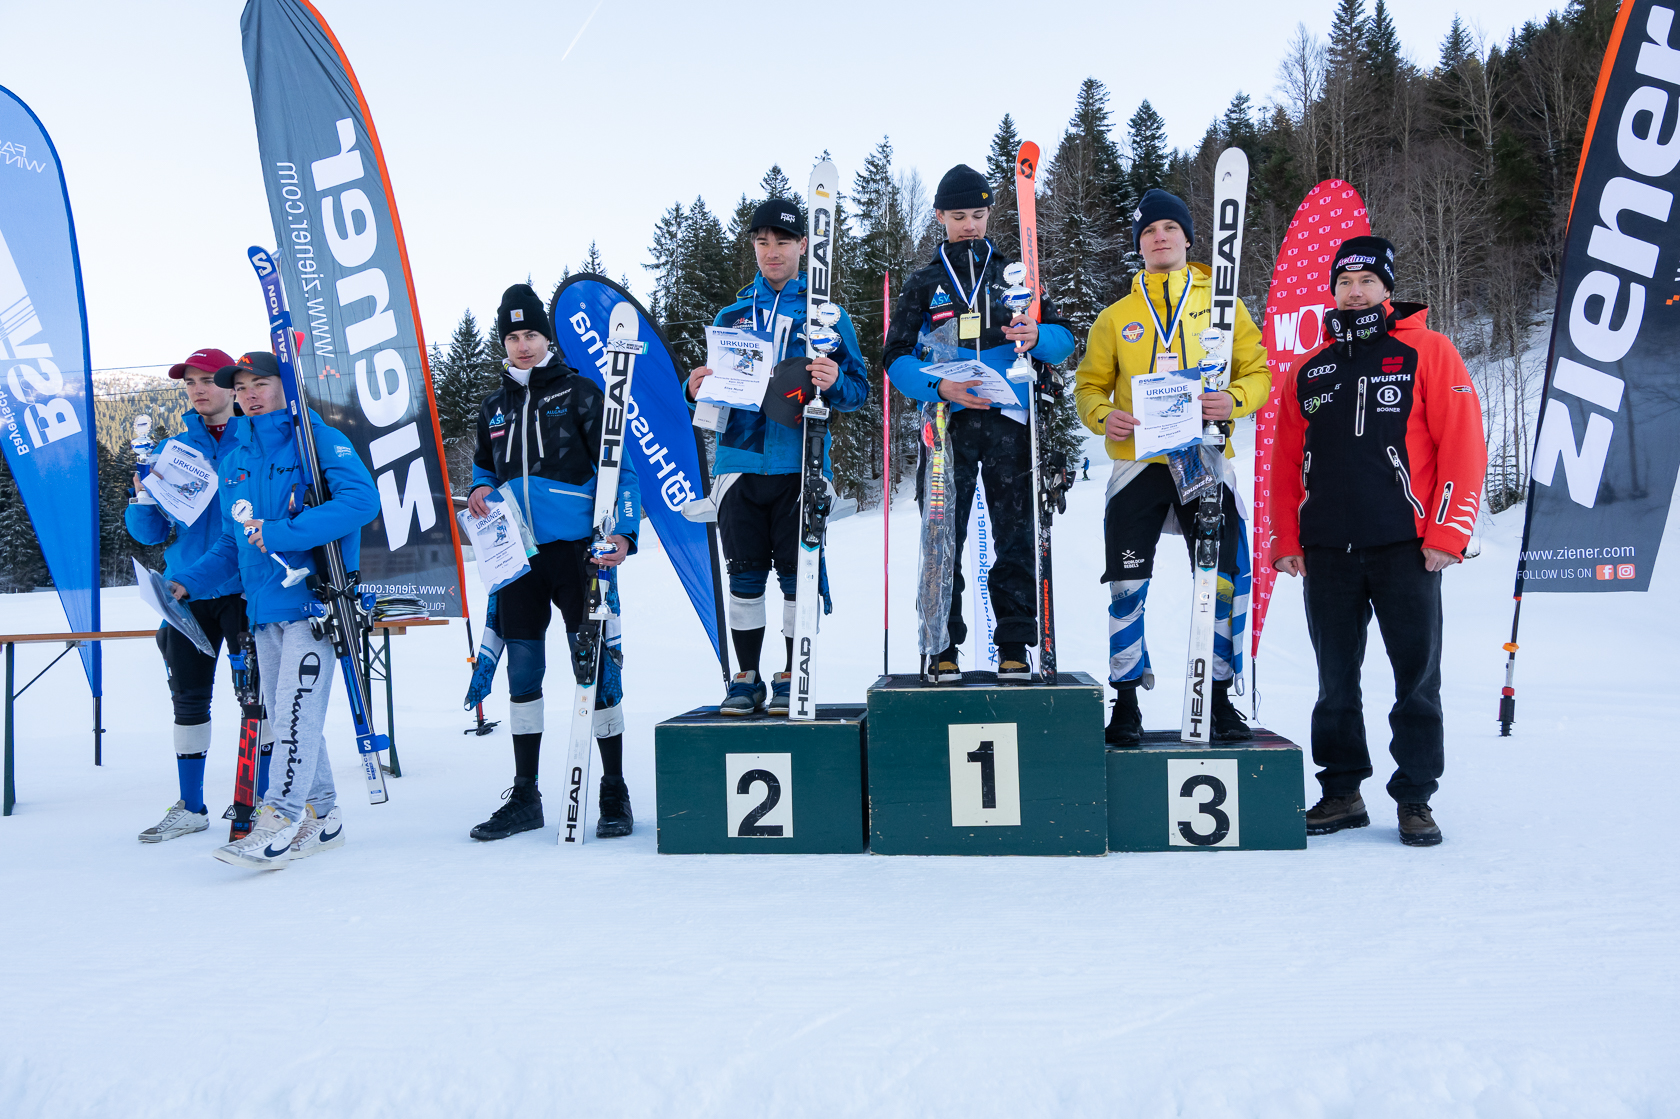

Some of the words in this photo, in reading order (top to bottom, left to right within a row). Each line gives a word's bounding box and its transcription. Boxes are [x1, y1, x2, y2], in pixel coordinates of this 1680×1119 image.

[810, 207, 831, 327] HEAD
[1213, 198, 1239, 331] HEAD
[1335, 253, 1376, 270] Actimel
[1531, 5, 1680, 509] ziener
[930, 293, 951, 307] ASV
[1274, 304, 1334, 355] WO
[720, 339, 761, 350] URKUNDE
[489, 414, 506, 427] ASV
[601, 351, 629, 469] HEAD
[1146, 384, 1189, 396] URKUNDE
[173, 457, 211, 481] URKUNDE
[475, 508, 502, 530] URKUNDE
[1516, 569, 1558, 580] FOLLOW
[1560, 568, 1575, 579] US
[1577, 568, 1592, 578] ON
[1519, 546, 1635, 561] www.ziener.com
[797, 636, 811, 717] HEAD
[1190, 657, 1206, 738] HEAD
[281, 651, 321, 798] Champion
[564, 766, 582, 843] HEAD
[736, 769, 784, 837] 2
[966, 740, 997, 809] 1
[1177, 774, 1230, 846] 3
